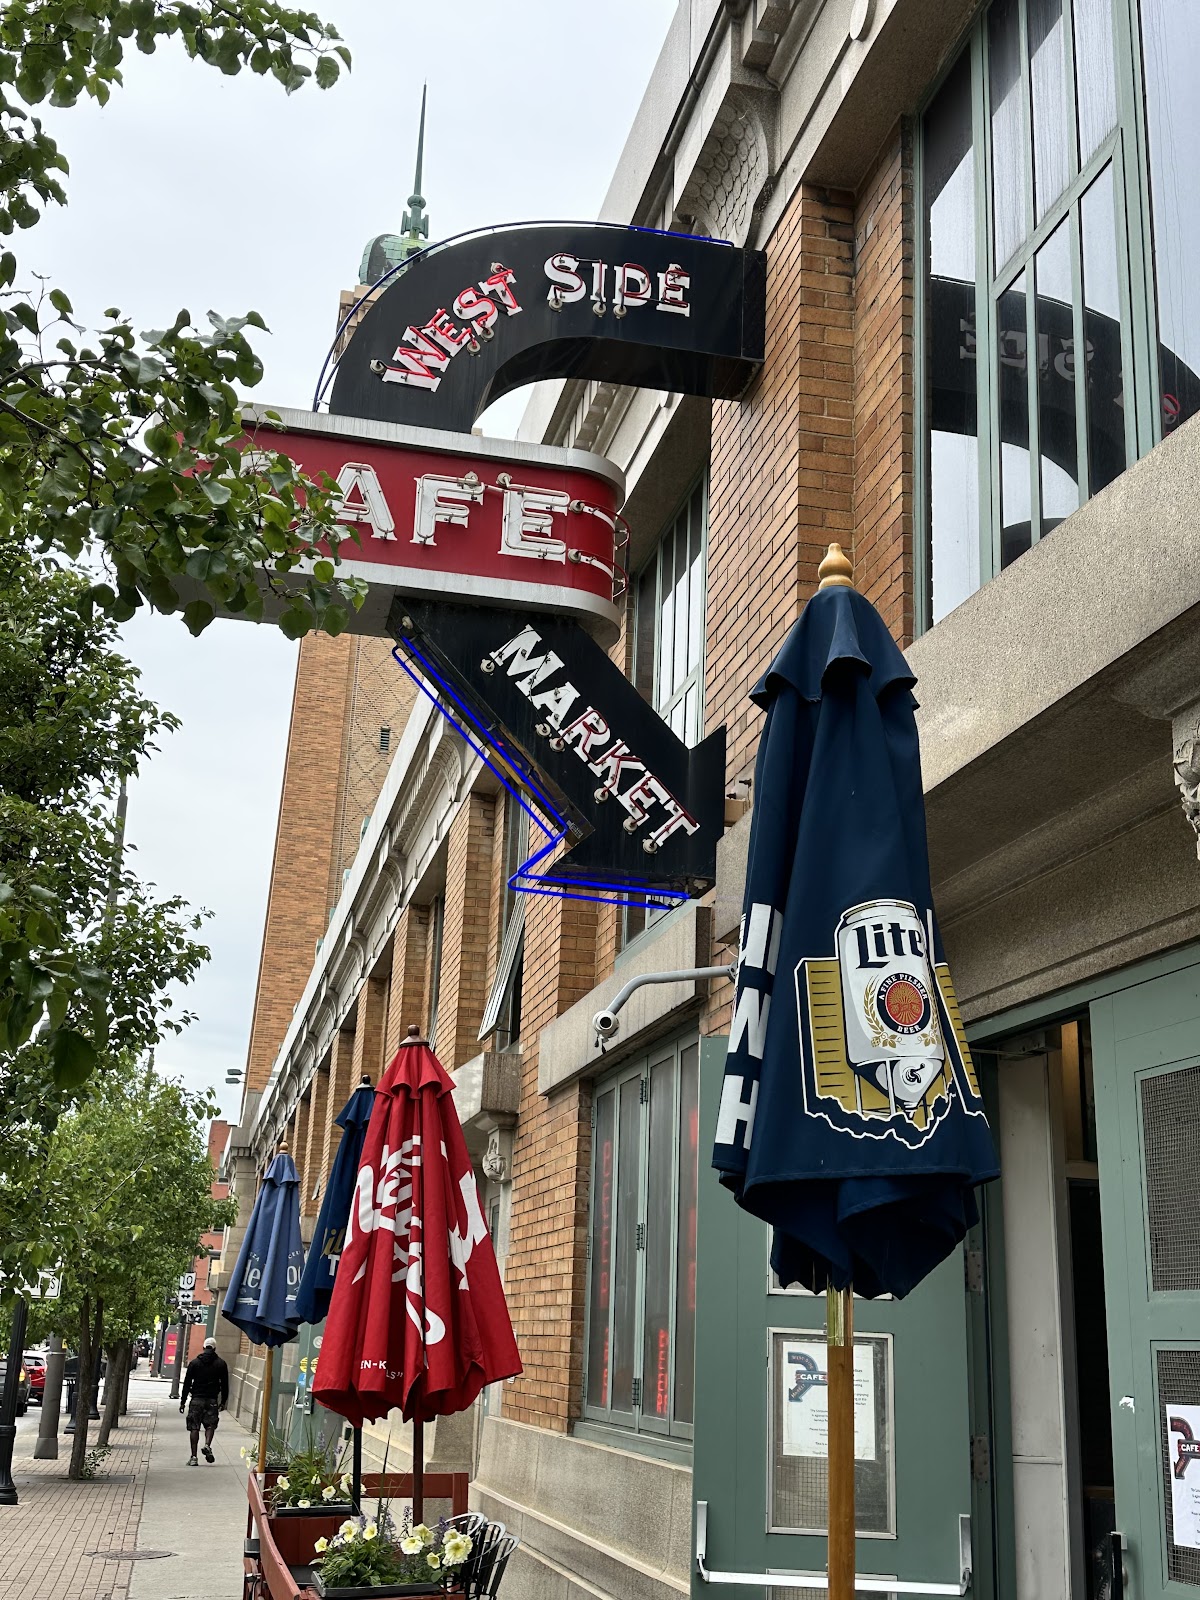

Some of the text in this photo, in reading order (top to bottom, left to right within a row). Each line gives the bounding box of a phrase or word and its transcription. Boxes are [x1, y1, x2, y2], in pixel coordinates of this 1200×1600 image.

[381, 252, 691, 393] WEST SIDE
[489, 624, 701, 847] MARKET
[852, 922, 924, 970] Lite
[880, 975, 898, 992] FINE
[899, 973, 928, 1000] PILSNER
[182, 1275, 193, 1286] 10
[1181, 1444, 1199, 1453] CAFE
